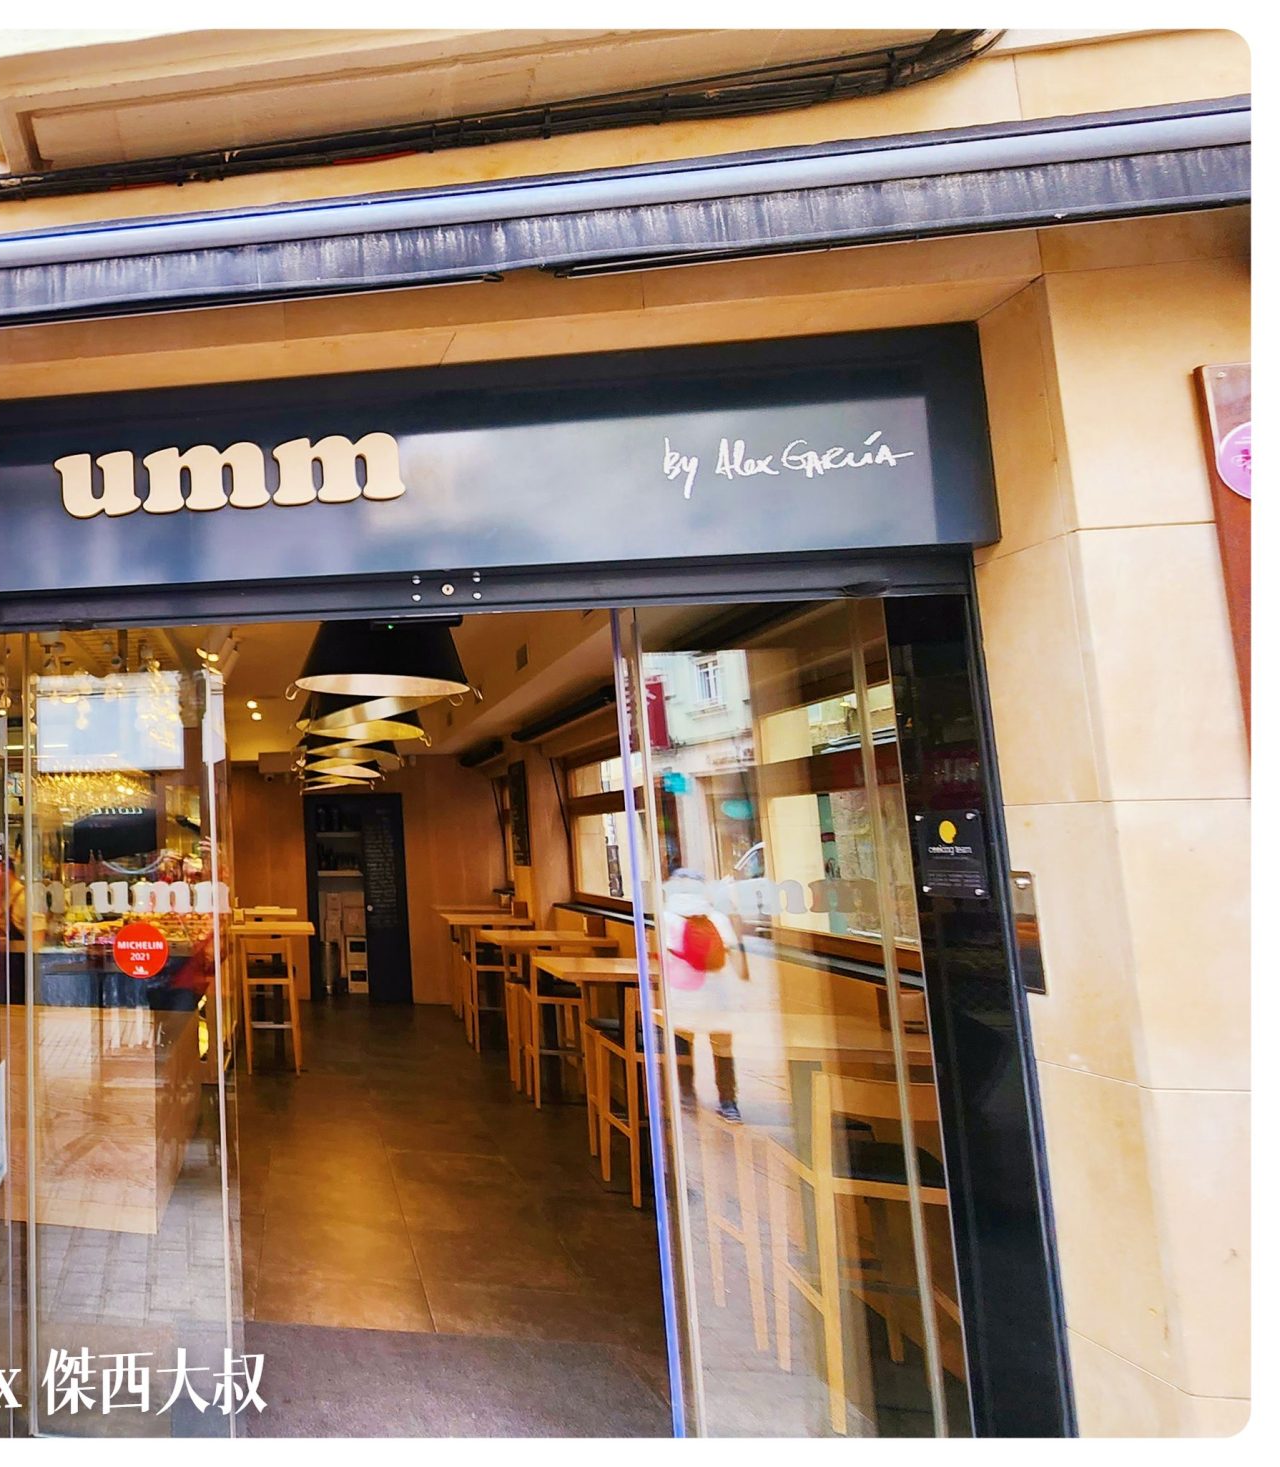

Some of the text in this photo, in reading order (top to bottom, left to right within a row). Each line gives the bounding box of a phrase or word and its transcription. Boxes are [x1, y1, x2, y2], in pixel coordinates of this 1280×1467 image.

[53, 429, 407, 519] umm
[664, 437, 698, 499] by
[715, 438, 780, 480] Alex
[117, 941, 164, 950] MICHELIN
[130, 952, 150, 961] 2021
